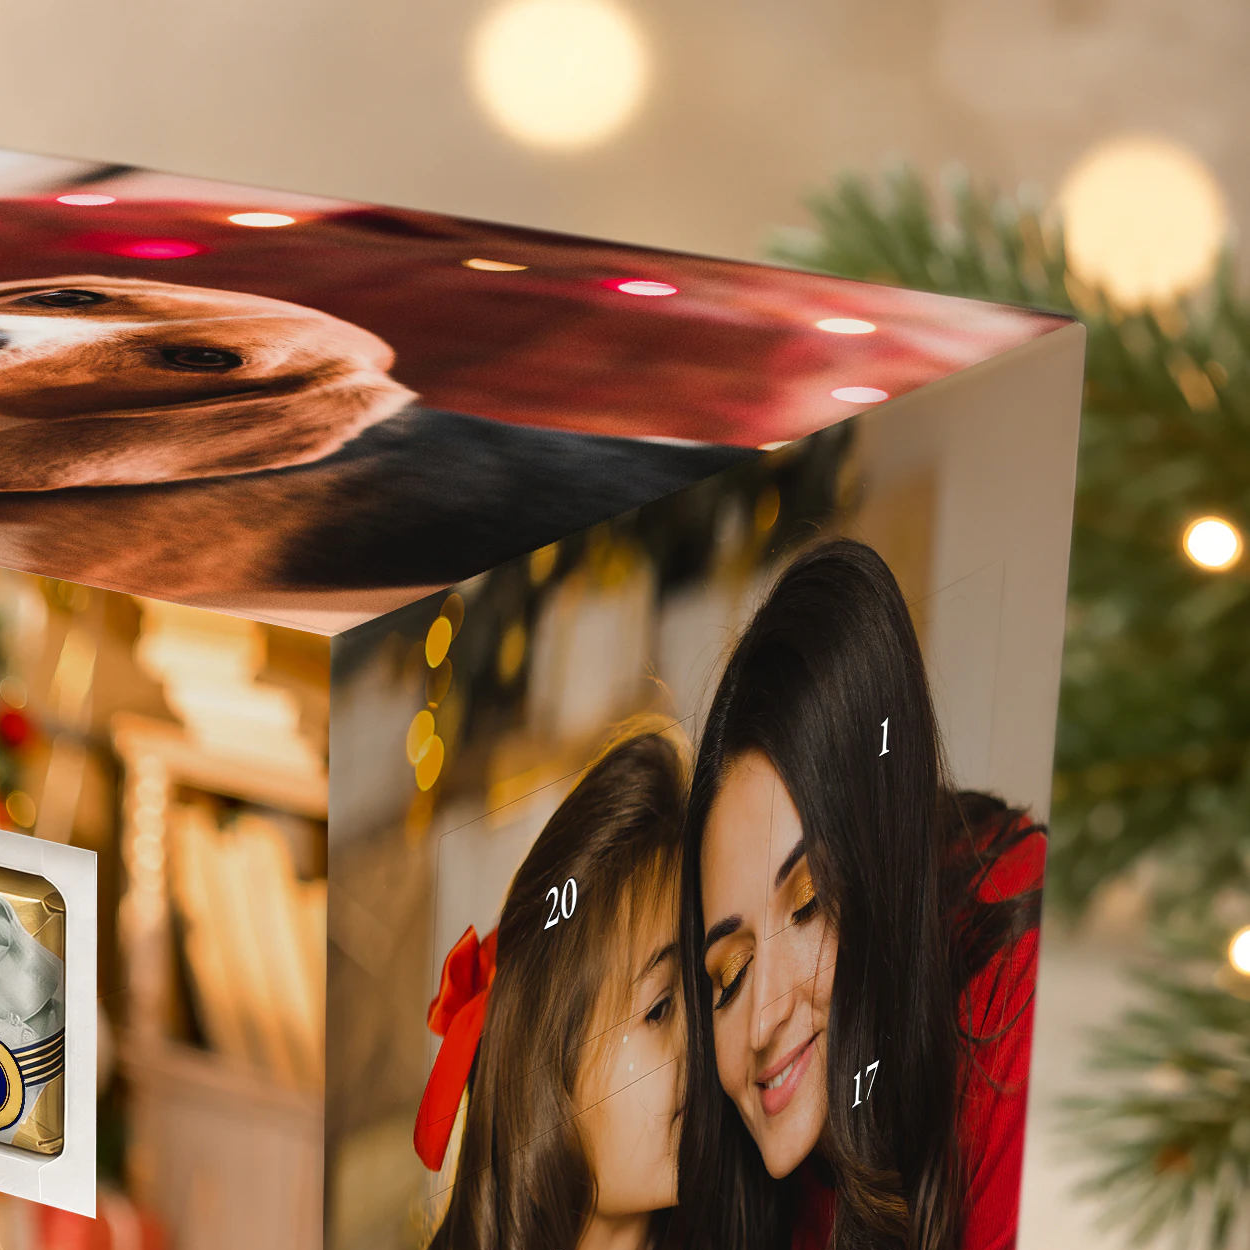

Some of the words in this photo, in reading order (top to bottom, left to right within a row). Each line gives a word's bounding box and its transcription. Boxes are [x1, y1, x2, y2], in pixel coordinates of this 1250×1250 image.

[879, 717, 890, 757] 1
[544, 878, 577, 931] 20
[851, 1060, 880, 1109] 17
